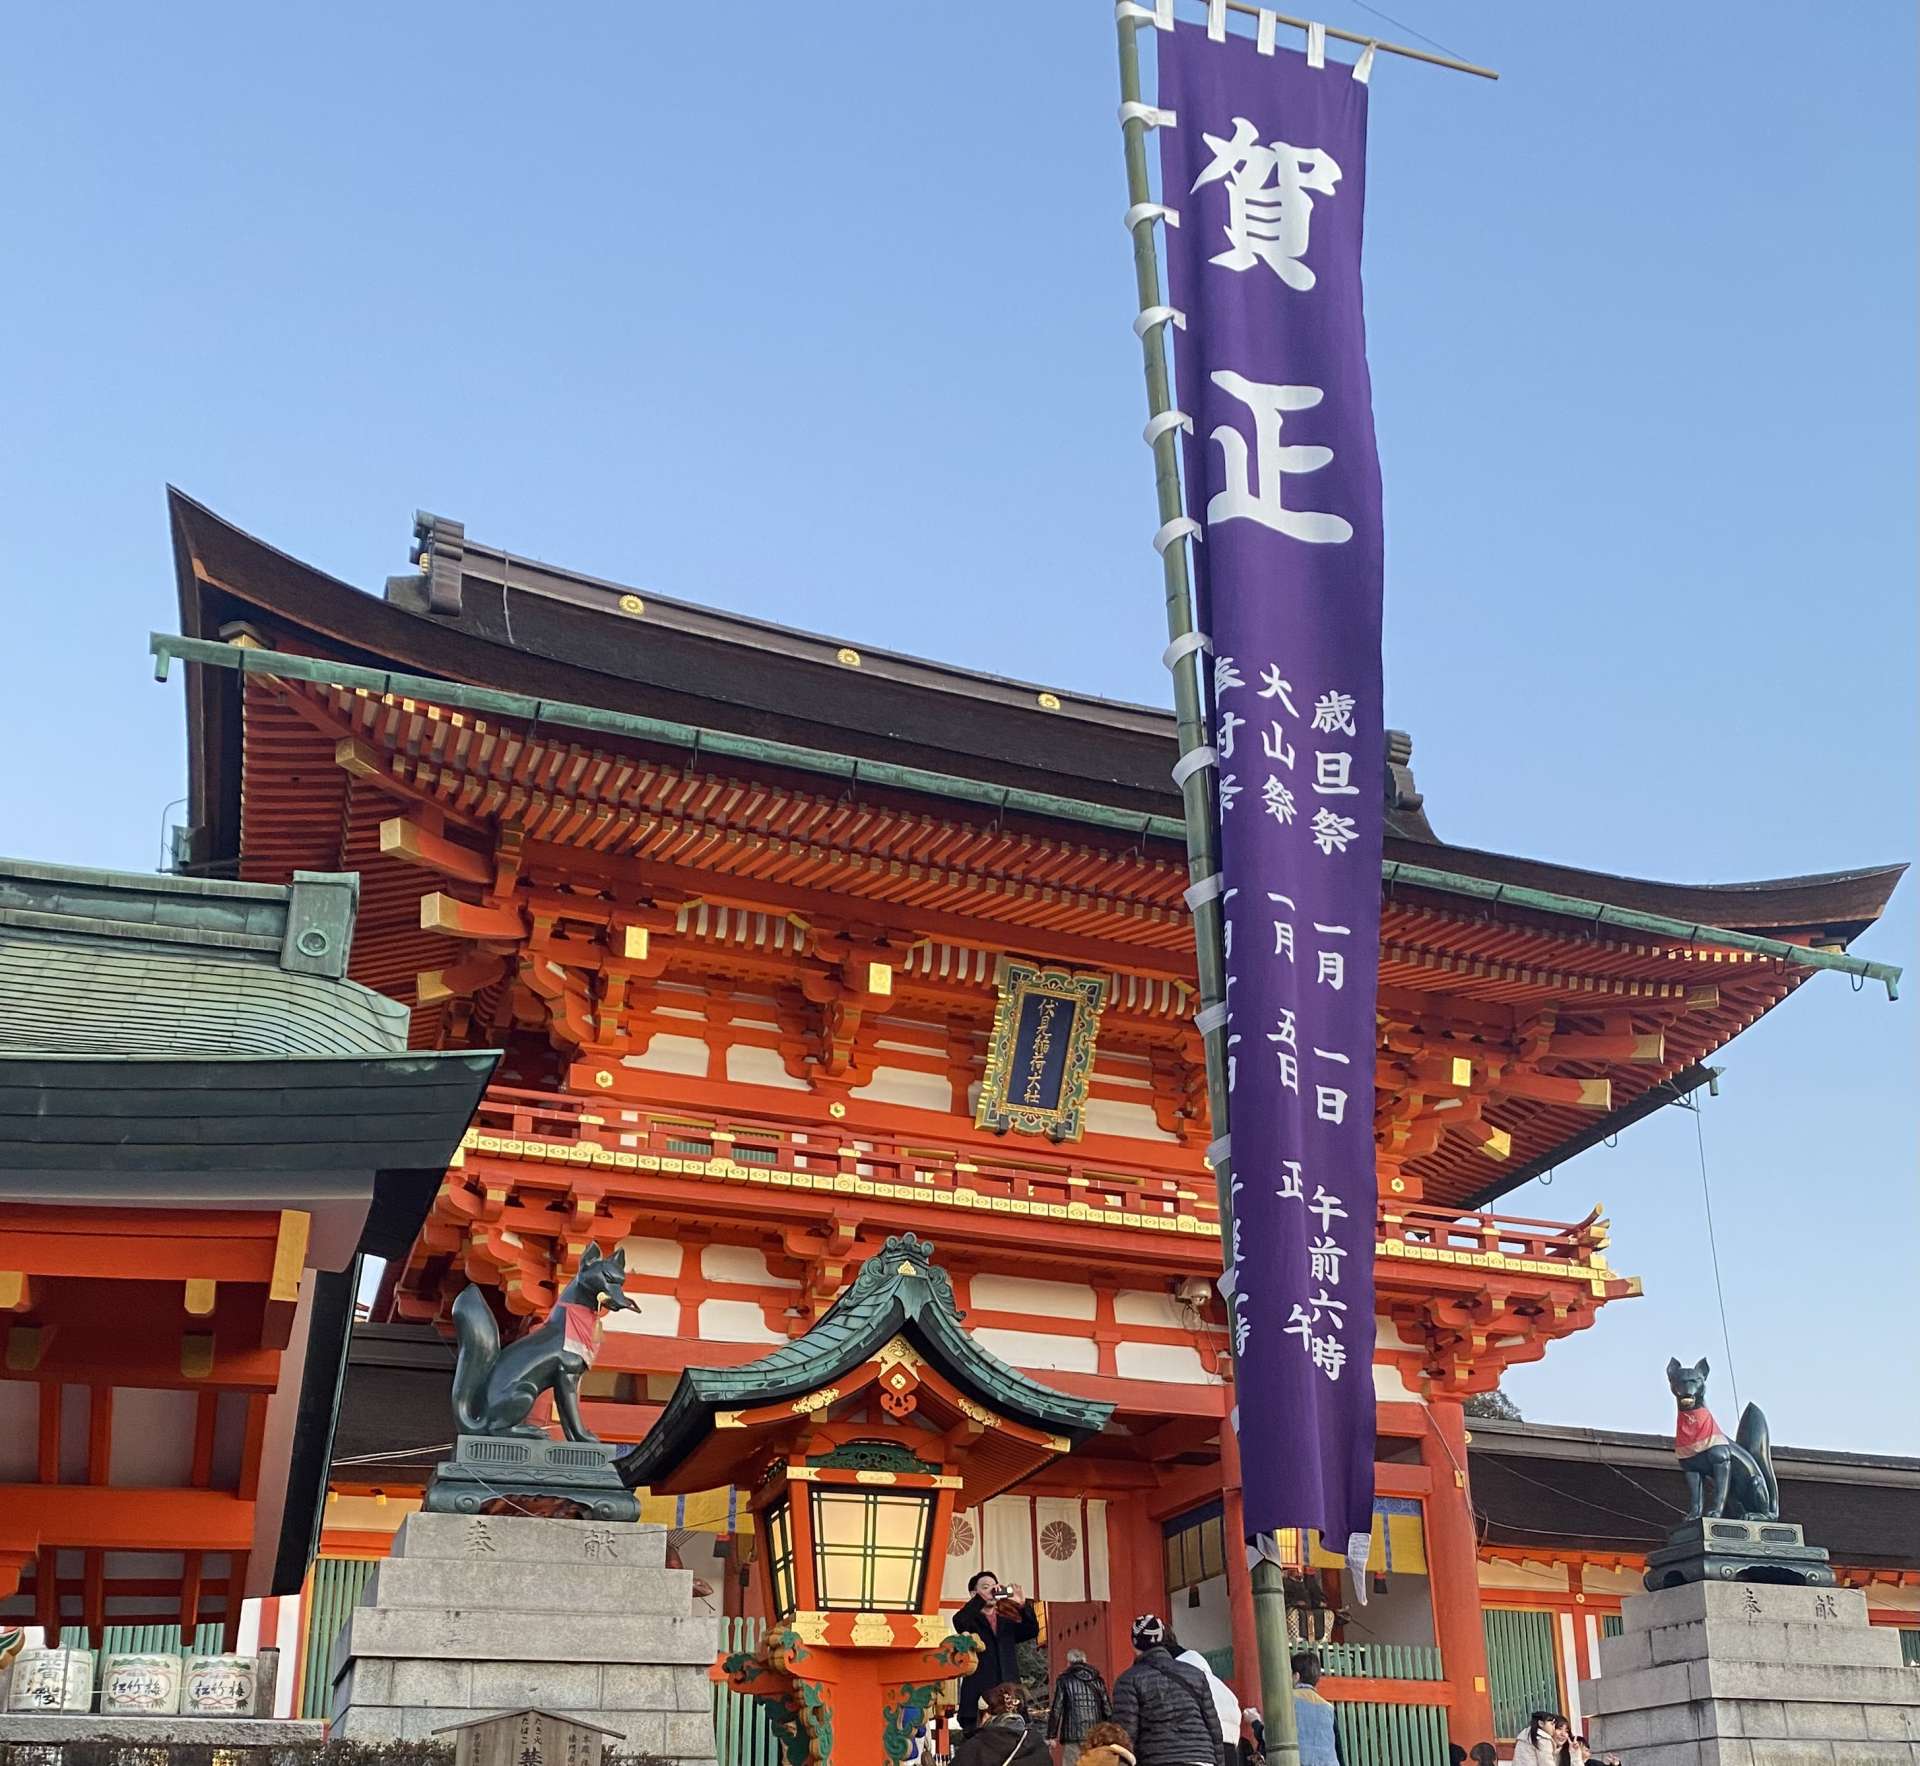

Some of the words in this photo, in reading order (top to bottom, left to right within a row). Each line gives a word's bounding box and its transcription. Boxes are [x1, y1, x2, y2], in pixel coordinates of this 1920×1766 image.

[1190, 116, 1354, 544] 賀正
[1256, 662, 1300, 826] 大山祭
[1309, 690, 1360, 856] 歳旦祭
[1023, 998, 1059, 1105] 伏見稲荷大社
[1308, 1184, 1349, 1381] 午前六時
[194, 1679, 246, 1698] 松竹梅
[520, 1717, 530, 1745] たばこ
